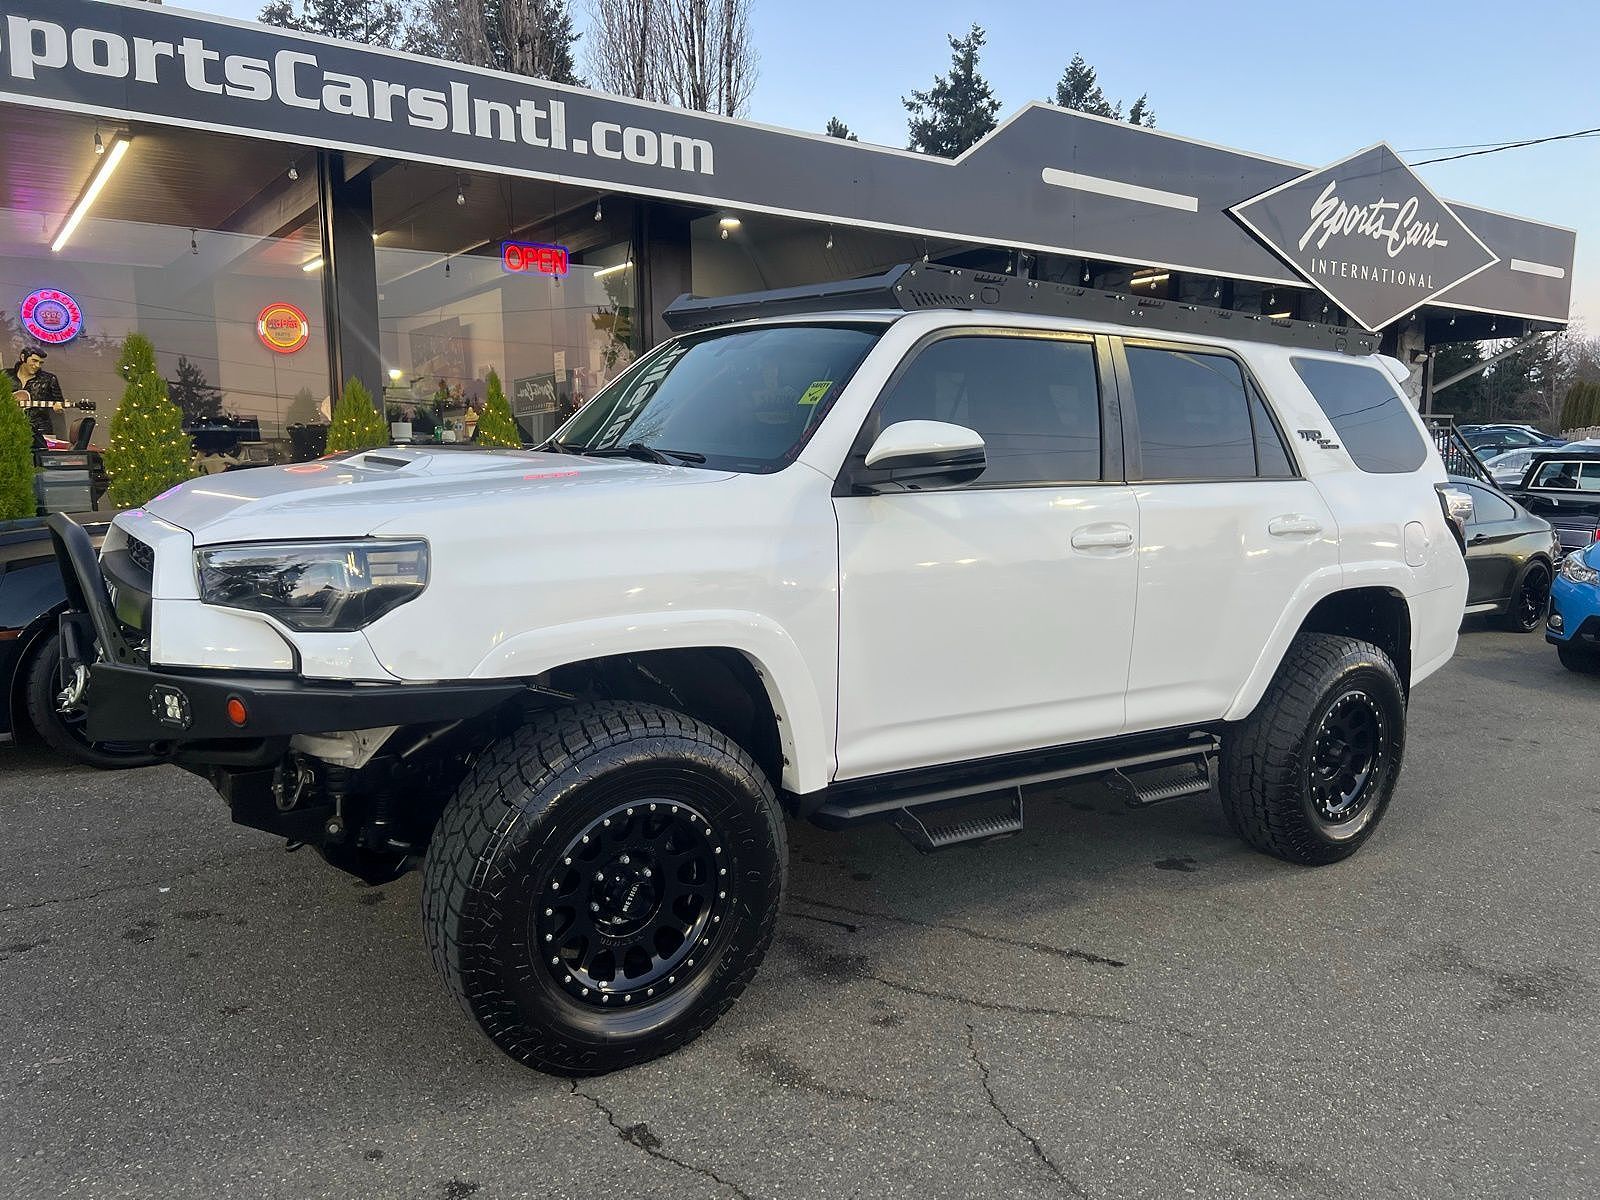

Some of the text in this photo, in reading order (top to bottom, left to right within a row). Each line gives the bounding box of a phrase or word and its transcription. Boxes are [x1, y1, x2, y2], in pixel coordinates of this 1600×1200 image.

[0, 14, 714, 175] portsCarsIntl.com
[1298, 180, 1448, 258] Sports Cars
[505, 245, 567, 275] OPEN
[1311, 258, 1434, 289] INTERNATIONAL
[622, 884, 639, 912] METHO
